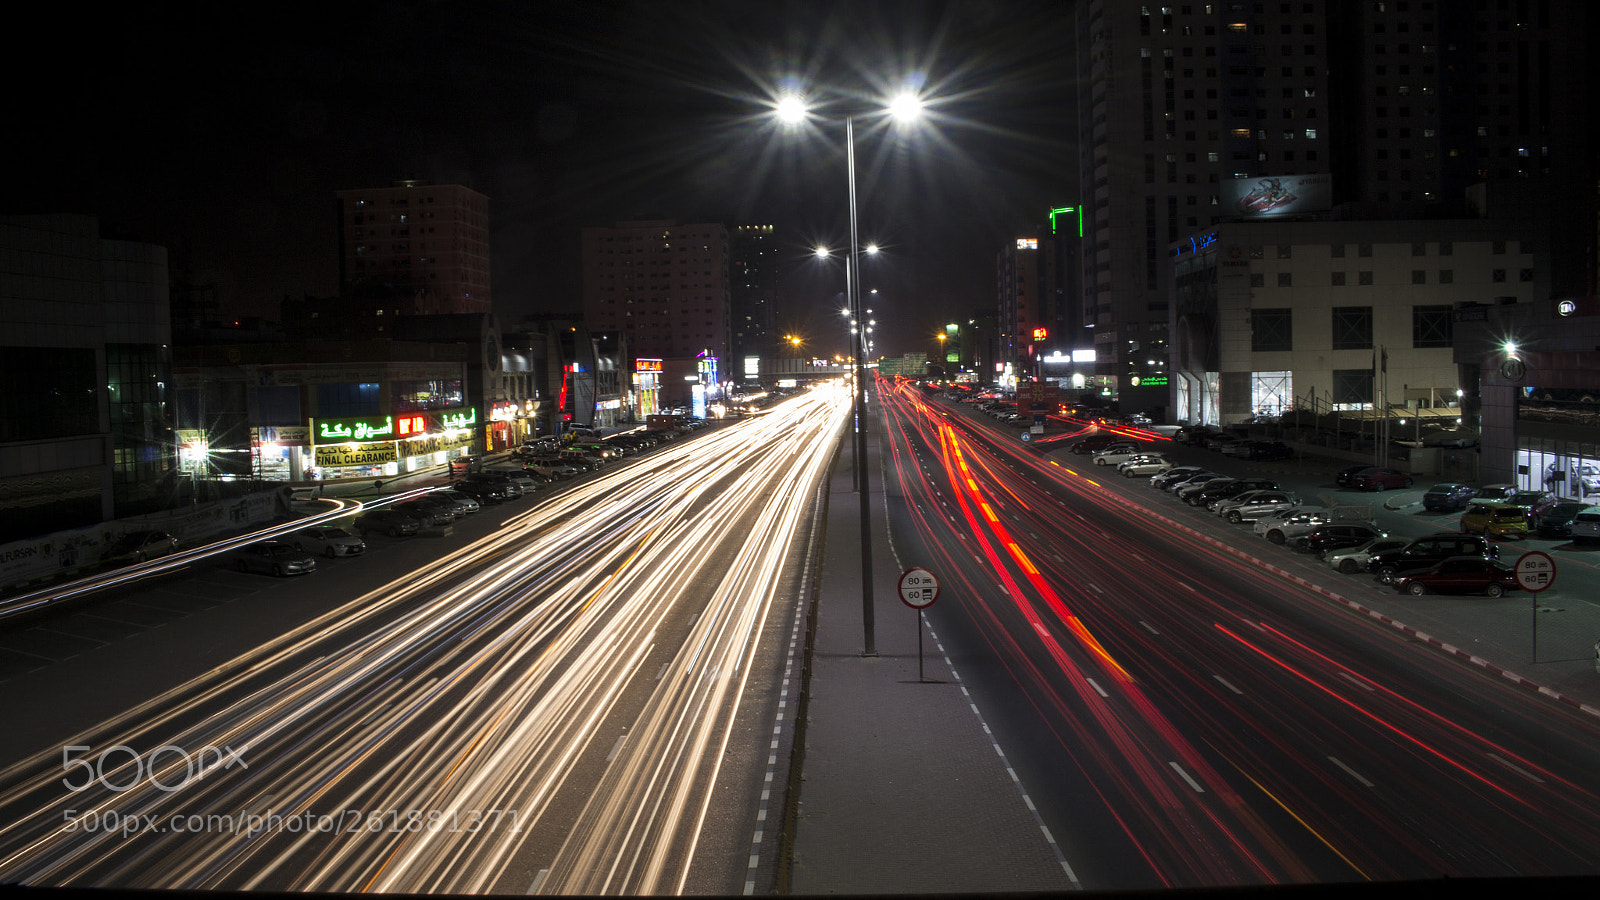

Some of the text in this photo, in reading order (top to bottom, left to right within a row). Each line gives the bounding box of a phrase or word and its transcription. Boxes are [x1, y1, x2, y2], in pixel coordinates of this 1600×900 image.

[316, 452, 396, 465] FINAL CLEARANCE
[908, 577, 920, 585] 80
[908, 591, 920, 599] 60
